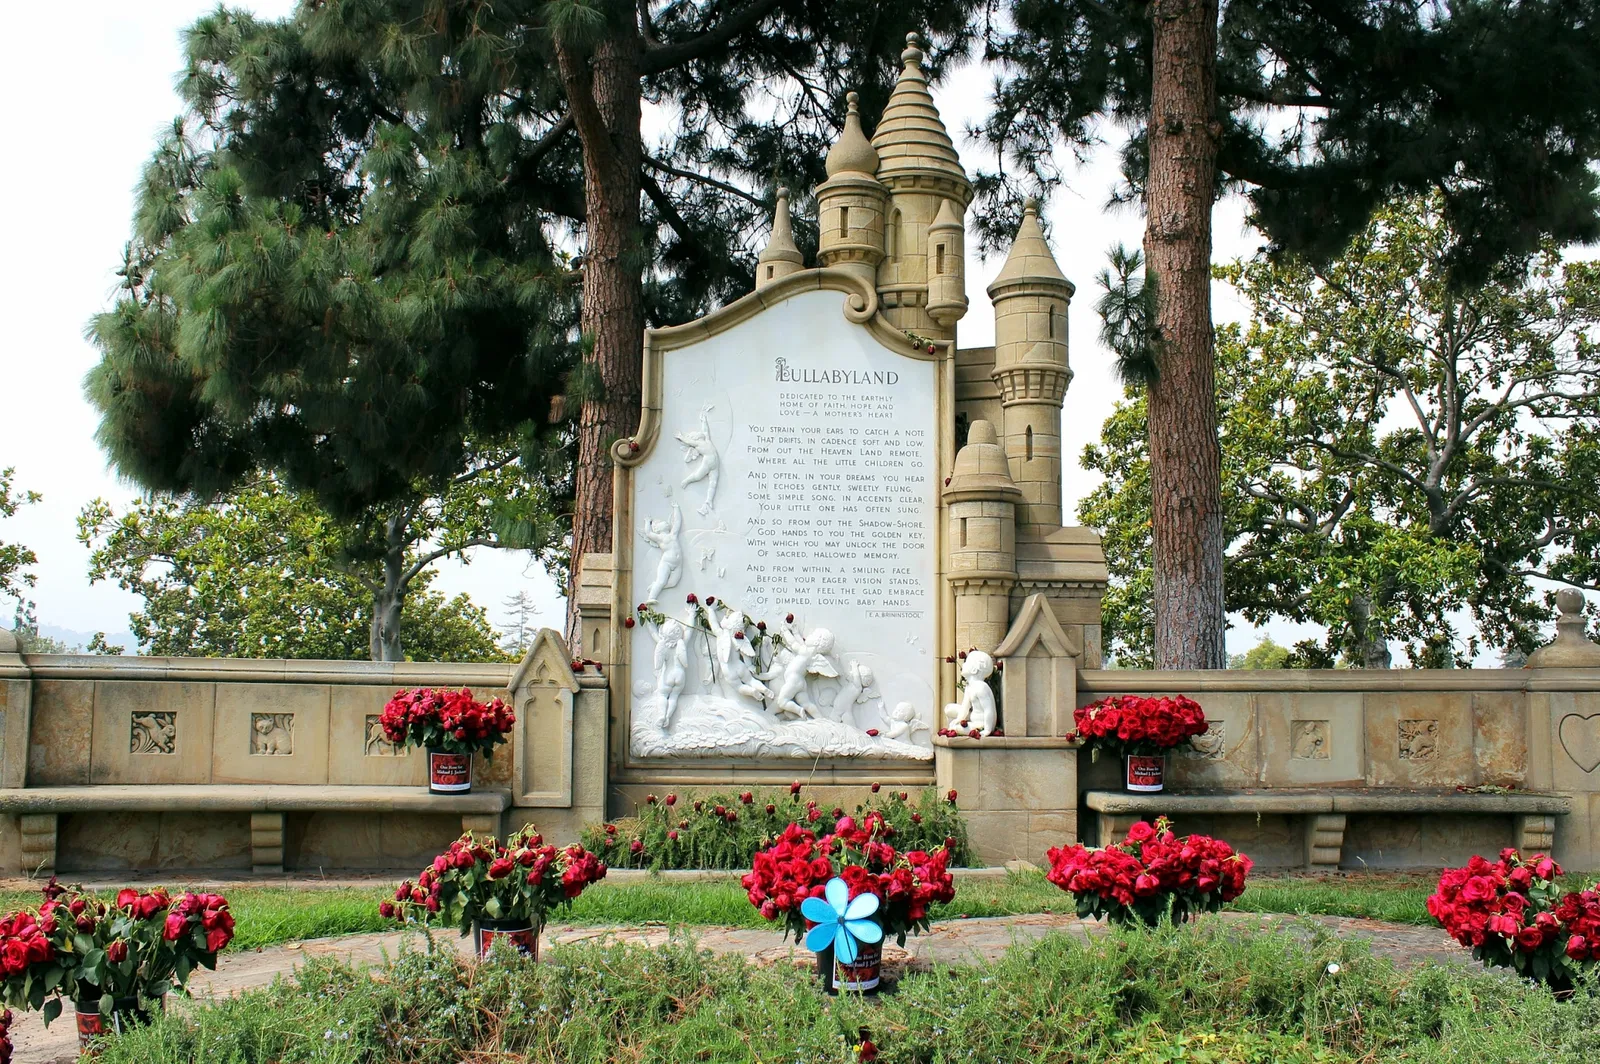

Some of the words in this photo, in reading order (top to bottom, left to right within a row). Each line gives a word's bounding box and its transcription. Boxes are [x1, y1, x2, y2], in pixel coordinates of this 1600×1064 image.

[775, 356, 898, 384] LULLABYLAND
[748, 471, 766, 479] AND
[748, 492, 770, 500] SOME
[747, 517, 766, 525] AND
